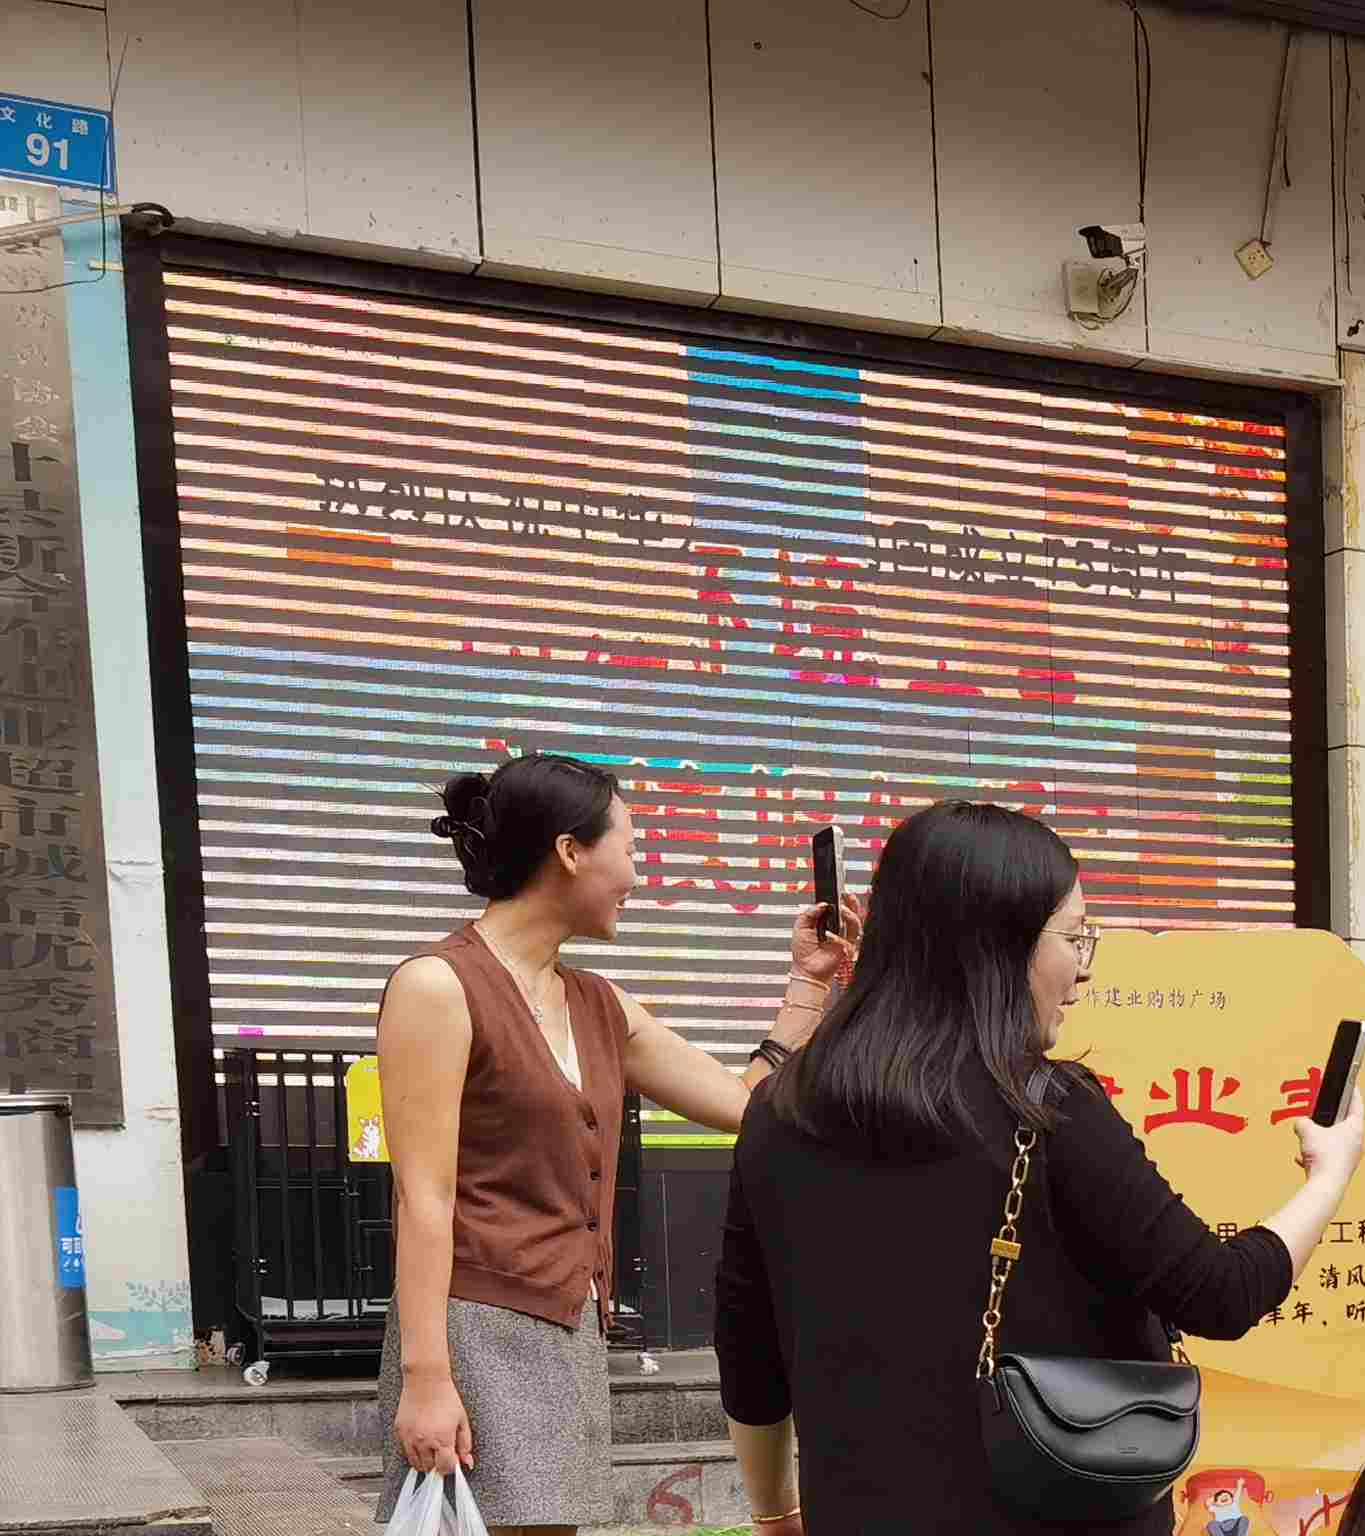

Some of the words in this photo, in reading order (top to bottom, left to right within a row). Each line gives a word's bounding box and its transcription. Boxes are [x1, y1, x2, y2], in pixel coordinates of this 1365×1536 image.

[0, 105, 89, 135] 文化路
[26, 133, 69, 170] 91
[1078, 986, 1227, 1012] 作建业购物广场
